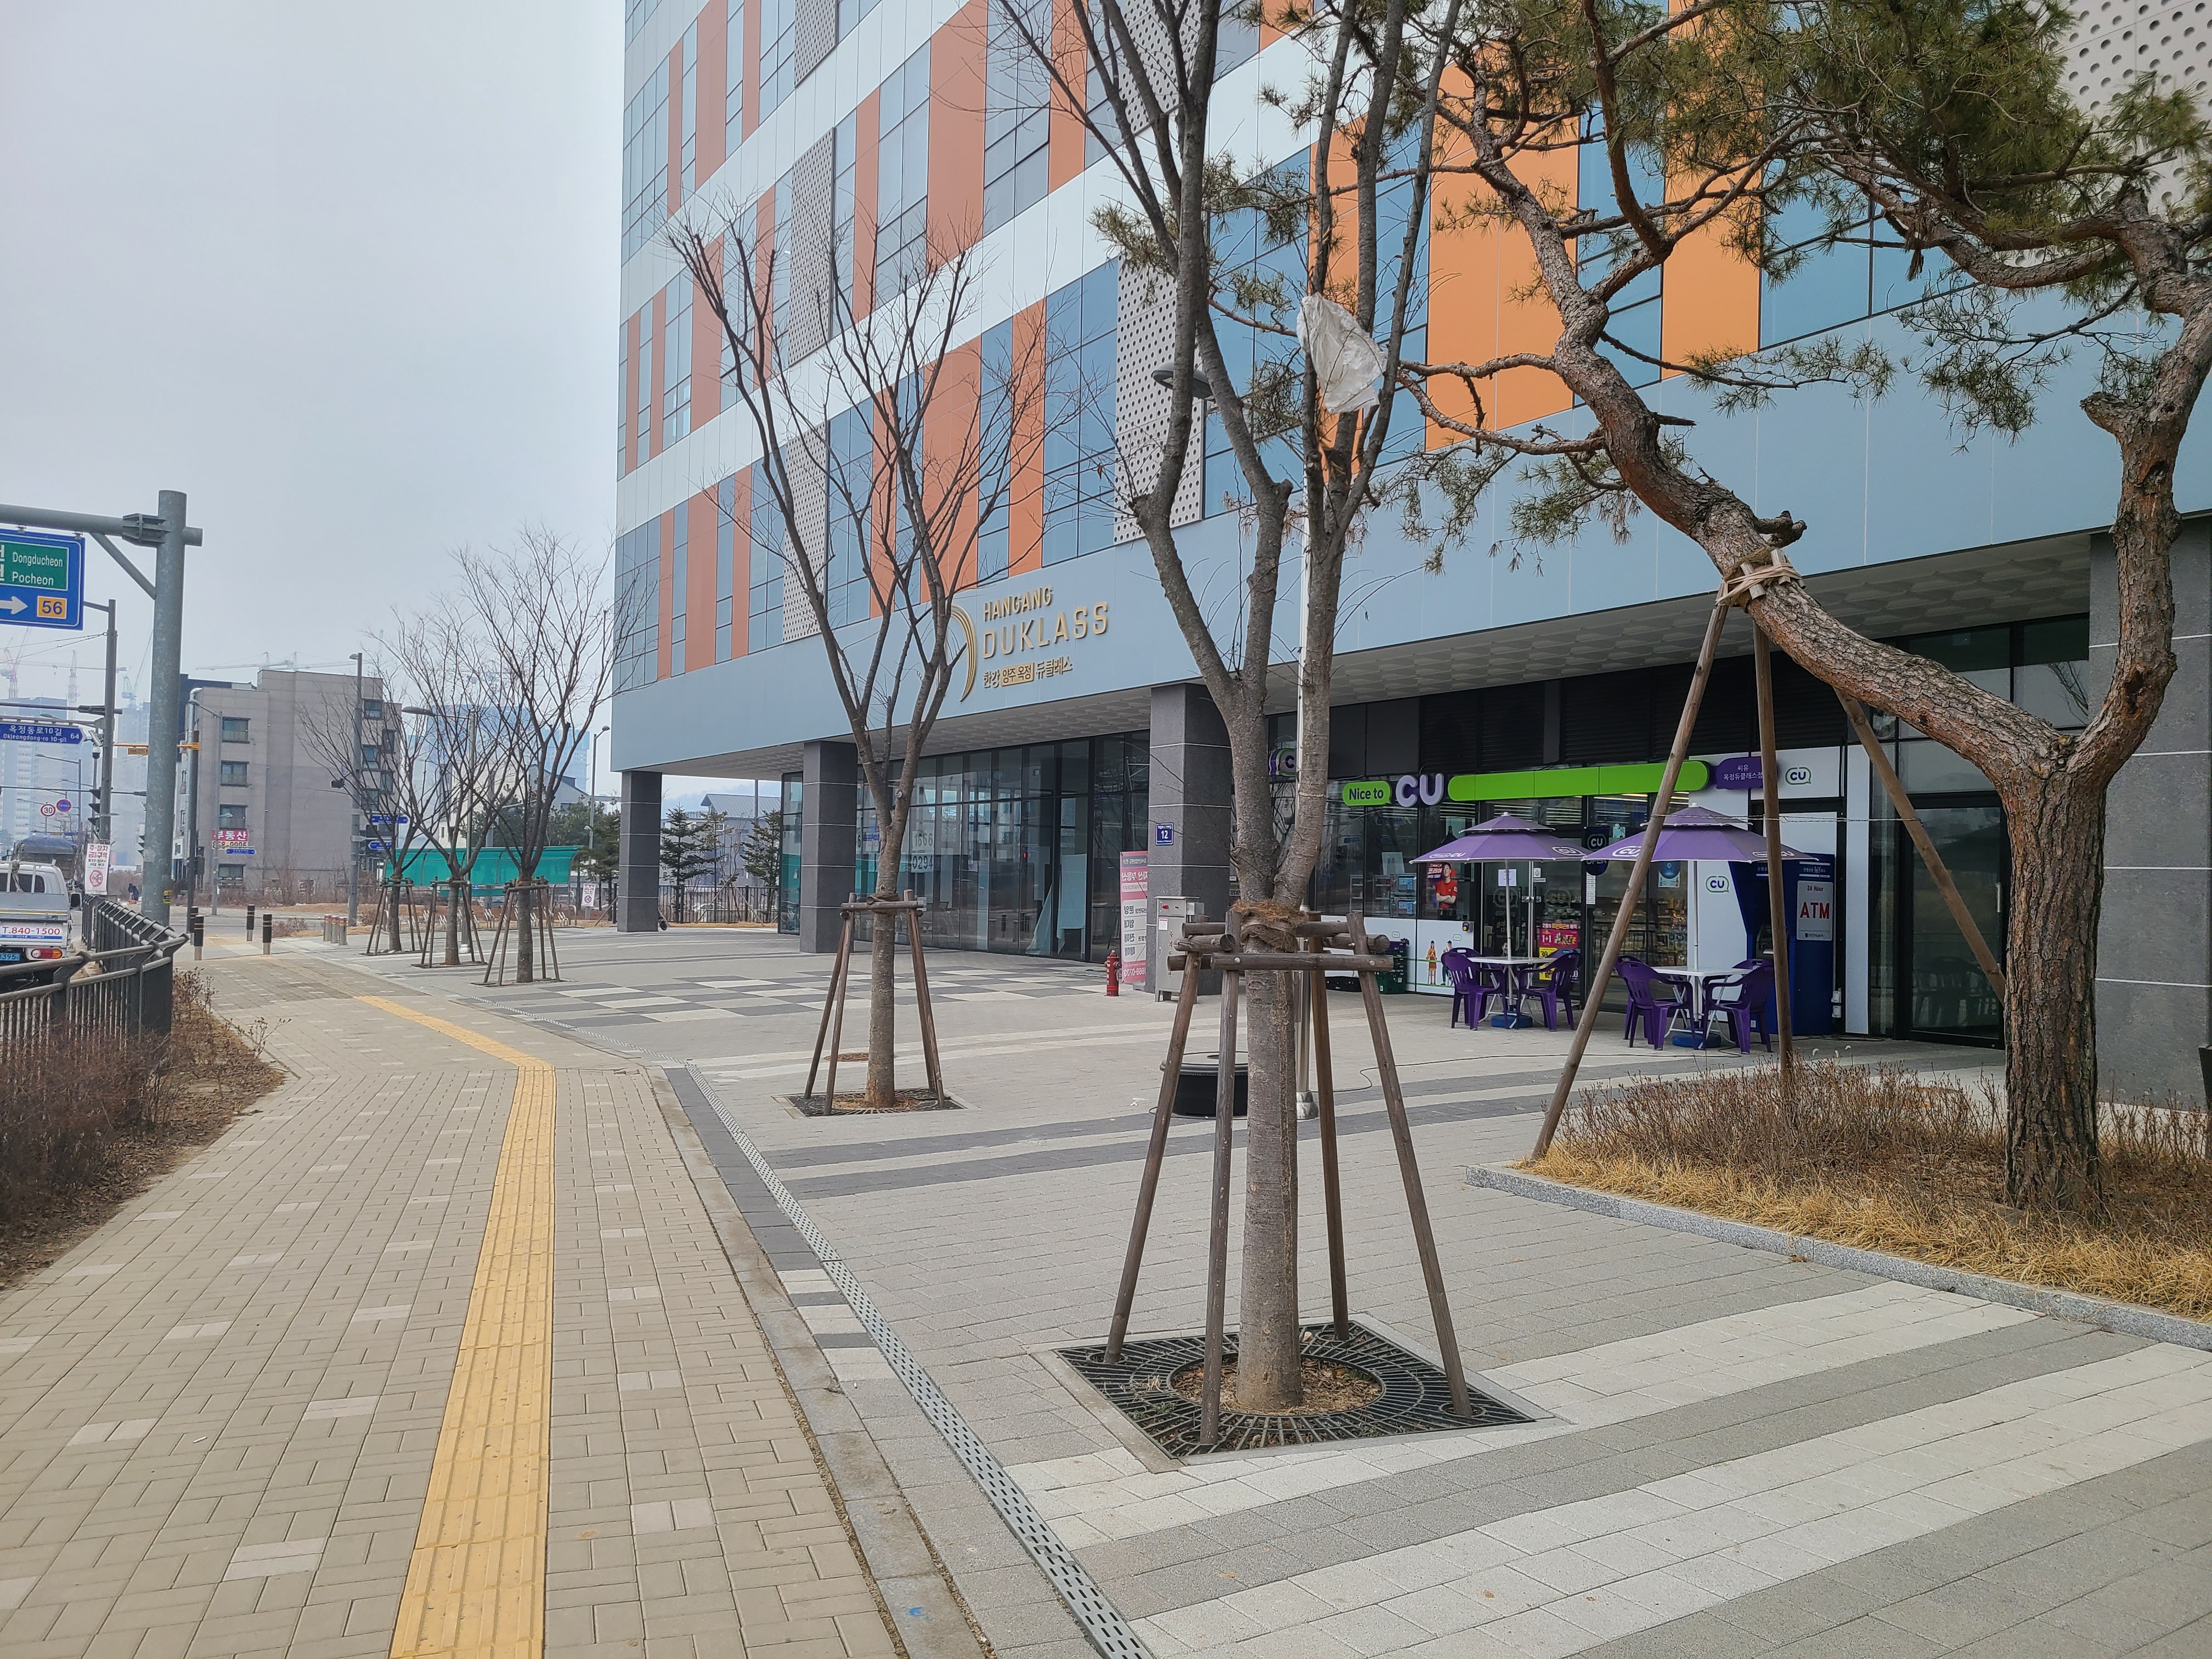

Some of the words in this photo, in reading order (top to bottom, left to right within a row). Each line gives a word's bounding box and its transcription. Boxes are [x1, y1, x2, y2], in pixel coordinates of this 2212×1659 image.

[13, 552, 63, 567] Dongducheon
[12, 571, 54, 585] Pocheon
[42, 601, 63, 614] 56
[983, 585, 1053, 622] HANGANG
[983, 601, 1109, 659] DUKLASS
[983, 669, 1000, 689] 한강
[1002, 667, 1017, 684] 양주
[1017, 664, 1031, 680] 옥정
[1035, 656, 1073, 680] 듀클래스
[8, 725, 62, 737] 옥정동로10길
[3, 733, 49, 742] Okjeongdong-ro
[1723, 772, 1763, 781] 옥정듀클래스점
[1790, 771, 1806, 781] CU
[1349, 788, 1371, 800] Nice
[1373, 788, 1384, 799] to
[1396, 774, 1444, 808] CU
[213, 830, 247, 840] 부동산
[915, 832, 933, 847] 1666
[1161, 830, 1169, 839] 12
[1591, 838, 1603, 847] CU
[912, 855, 933, 870] 0294
[1710, 880, 1725, 889] CU
[1799, 901, 1830, 919] ATM
[2, 927, 60, 935] T.840-1500
[1542, 935, 1551, 943] 1+1
